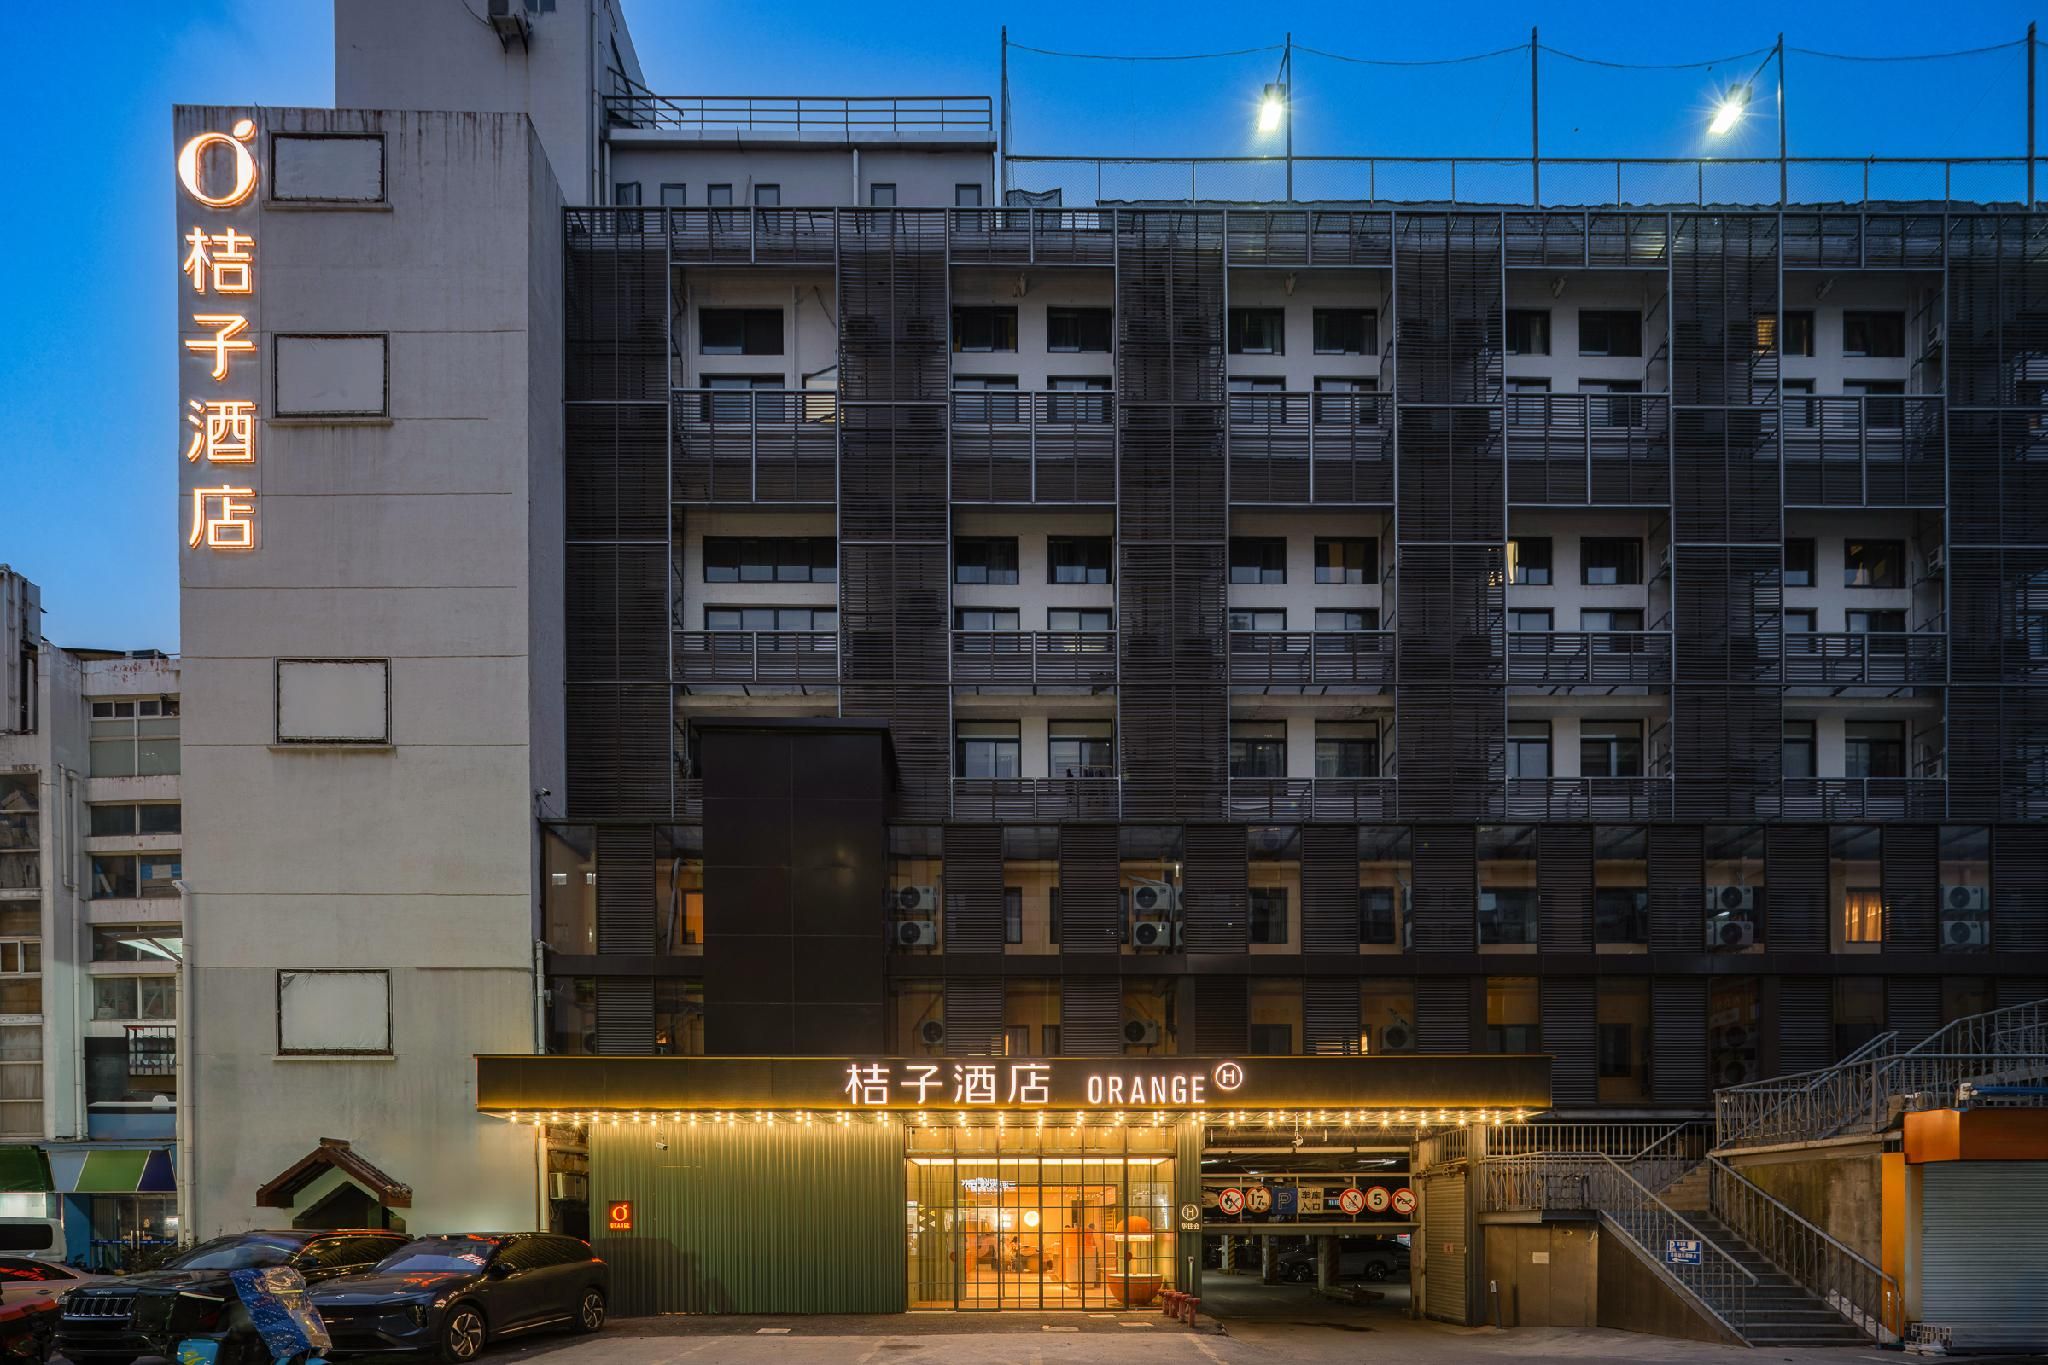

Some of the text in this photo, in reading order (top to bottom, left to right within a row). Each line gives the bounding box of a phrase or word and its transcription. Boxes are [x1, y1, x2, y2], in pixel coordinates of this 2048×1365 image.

[183, 225, 257, 550] 桔子酒店
[844, 1063, 1051, 1105] 桔子酒店
[1087, 1075, 1206, 1105] ORANGE
[1278, 1192, 1292, 1210] P
[1301, 1201, 1321, 1211] 入口
[1373, 1193, 1383, 1206] 5
